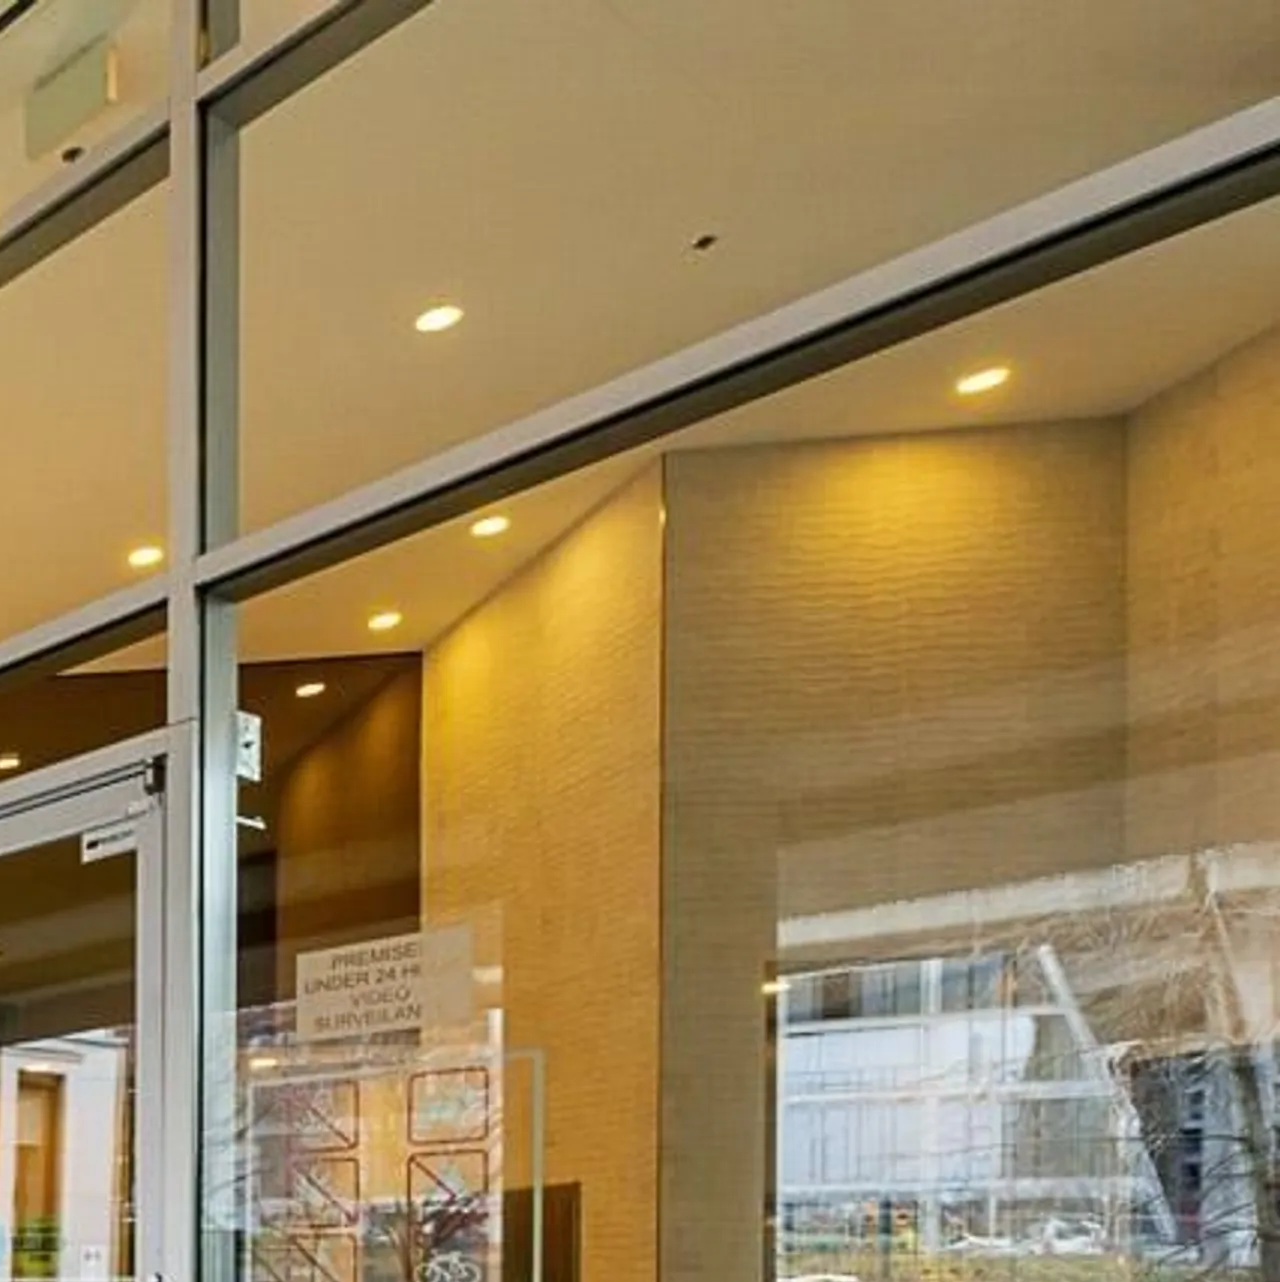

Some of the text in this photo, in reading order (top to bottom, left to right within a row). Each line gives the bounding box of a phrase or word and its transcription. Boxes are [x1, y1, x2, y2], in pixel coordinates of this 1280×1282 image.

[305, 970, 370, 994] UNDER
[376, 967, 396, 983] 24
[351, 985, 411, 1008] VIDEO
